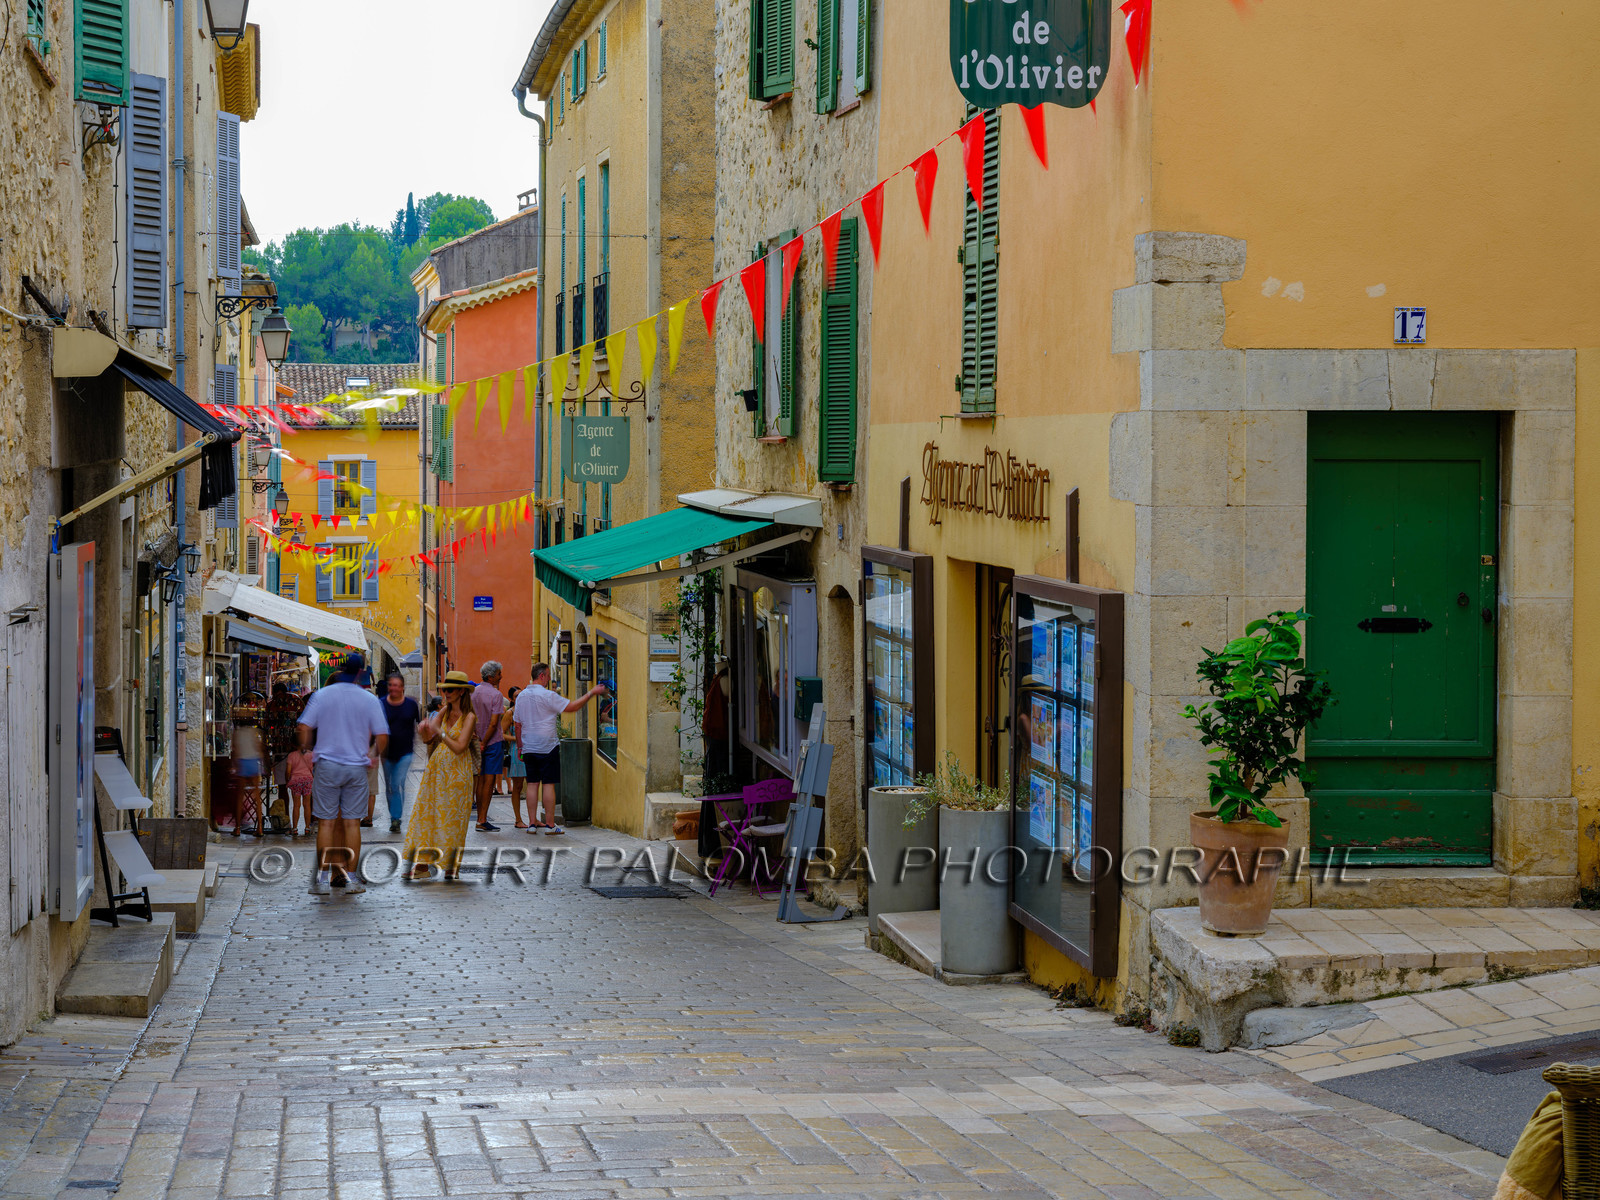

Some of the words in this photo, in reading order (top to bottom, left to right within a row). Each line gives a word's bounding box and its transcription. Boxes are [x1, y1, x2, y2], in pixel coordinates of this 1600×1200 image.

[1012, 10, 1050, 45] de
[959, 49, 1101, 90] l'Olivier
[1396, 311, 1426, 339] 17
[576, 423, 614, 440] Agence
[590, 443, 601, 457] de
[573, 461, 619, 476] l'Olivier
